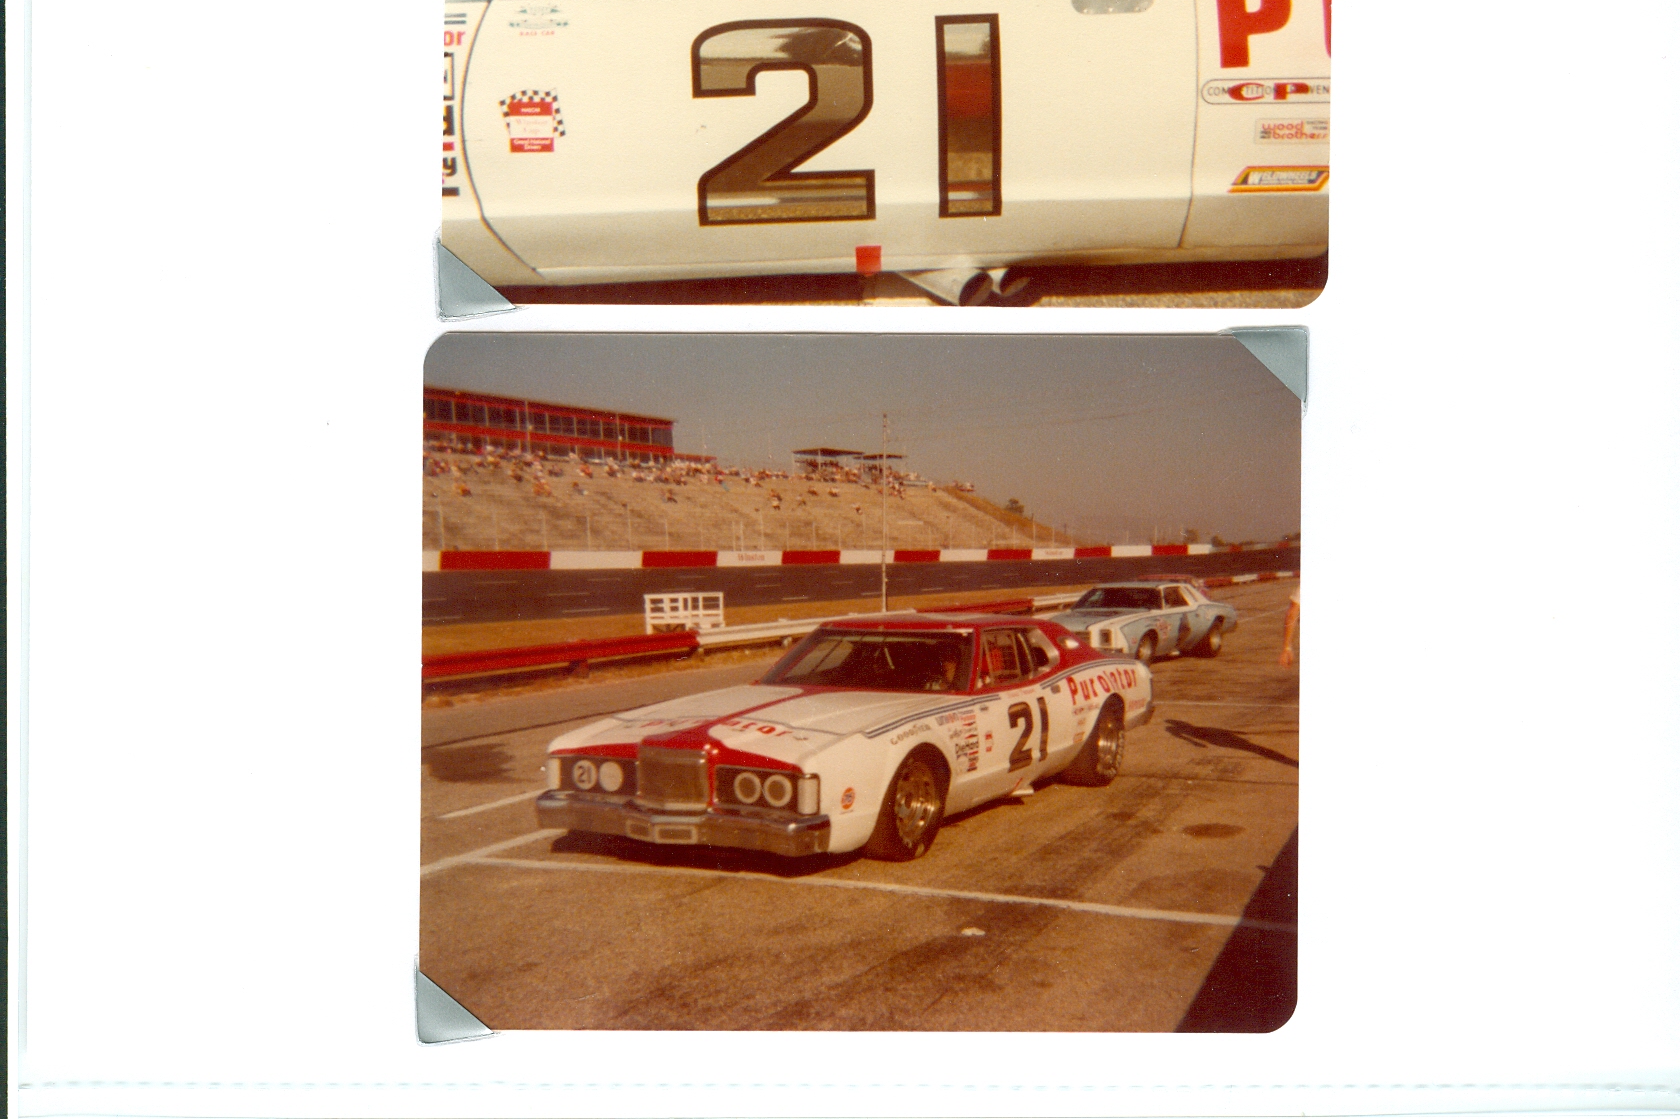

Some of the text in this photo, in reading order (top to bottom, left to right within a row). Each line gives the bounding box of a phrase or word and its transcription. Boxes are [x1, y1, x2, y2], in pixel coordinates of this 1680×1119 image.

[691, 13, 1002, 227] 21
[1261, 121, 1304, 132] wood
[1007, 696, 1049, 773] 21
[577, 765, 592, 784] 21
